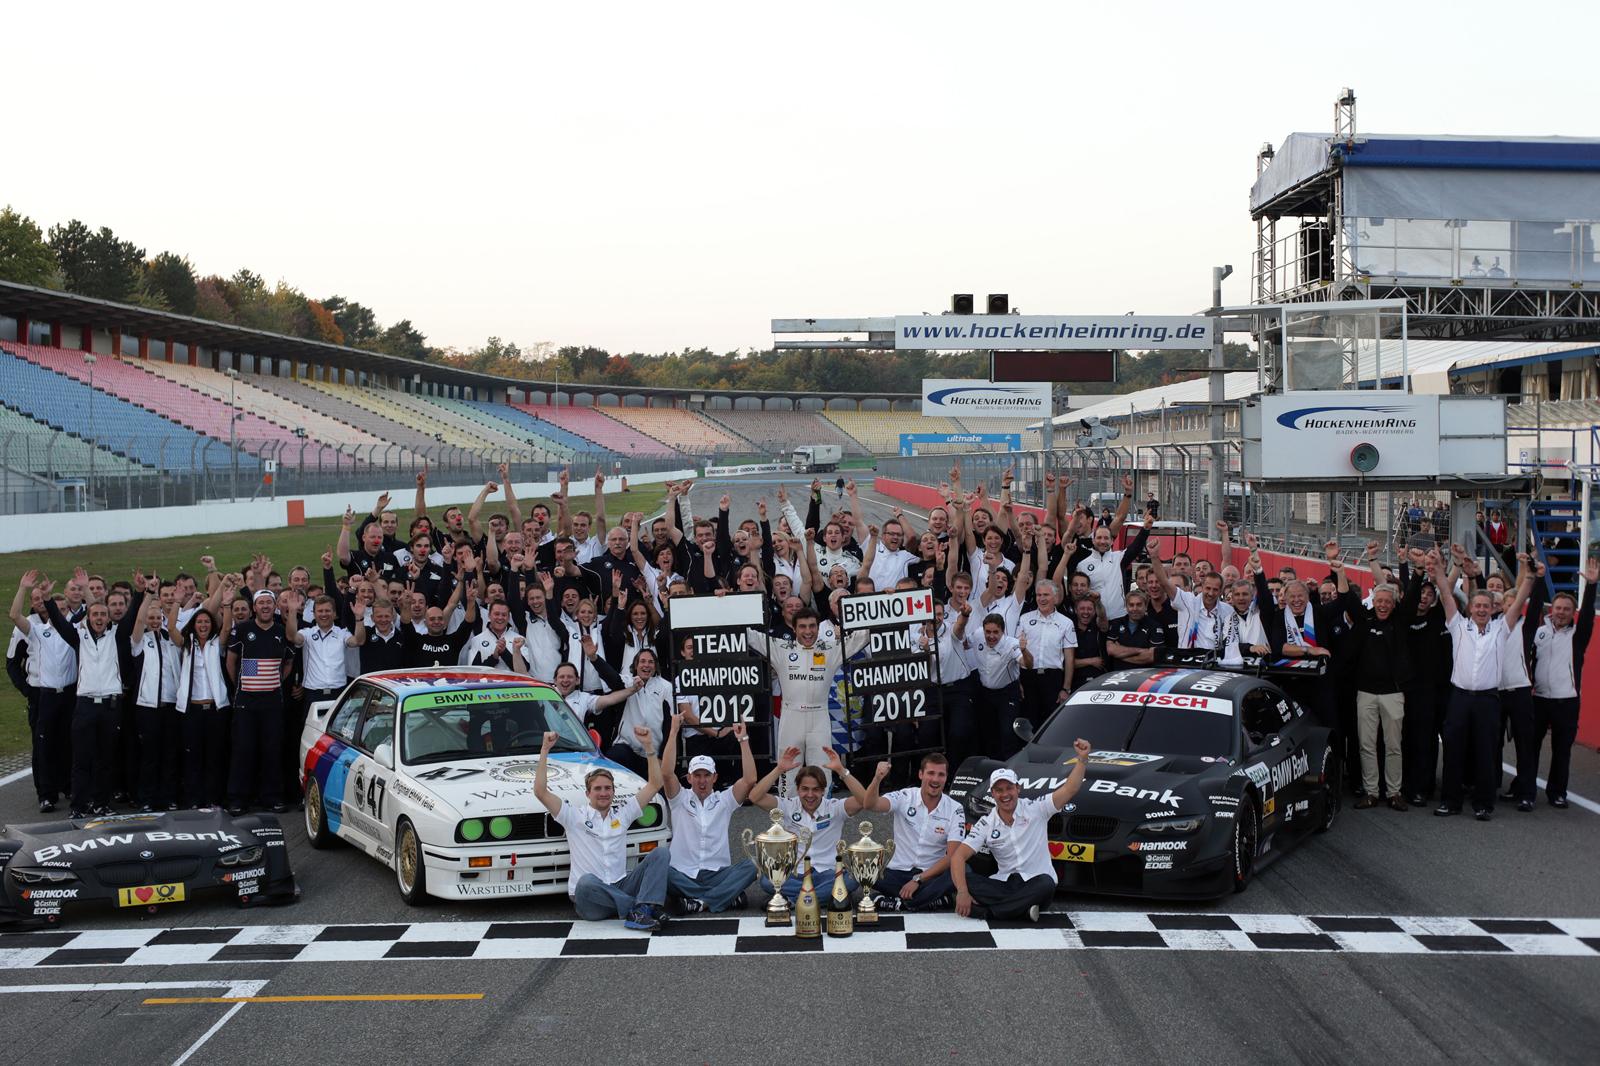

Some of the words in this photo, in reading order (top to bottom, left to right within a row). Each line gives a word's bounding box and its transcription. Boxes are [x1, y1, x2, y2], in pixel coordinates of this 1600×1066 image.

[903, 323, 1205, 342] www.hockenheimring.de
[946, 434, 982, 442] ultimate
[269, 461, 272, 470] 1
[844, 596, 904, 623] BRUNO
[422, 643, 450, 653] BRUNO
[694, 632, 746, 655] TEAM
[870, 629, 910, 653] DTM
[681, 665, 760, 688] CHAMPIONS
[788, 673, 808, 681] BMW
[853, 660, 929, 688] CHAMPION
[434, 693, 474, 705] BMW
[873, 689, 926, 723] 2012
[1120, 693, 1209, 709] BOSCH
[700, 694, 754, 724] 2012
[415, 766, 486, 781] 47
[1272, 758, 1292, 792] BMW
[1292, 748, 1309, 780] Bank
[367, 774, 386, 820] 47
[1089, 780, 1184, 808] Bank
[1146, 810, 1176, 819] SONAX
[33, 834, 134, 863] BMW
[146, 830, 242, 844] Bank
[1144, 862, 1173, 870] EDGE
[127, 890, 132, 904] I
[238, 885, 260, 896] EDGE
[456, 883, 534, 896] WARSTEINER
[34, 907, 61, 915] EDGE
